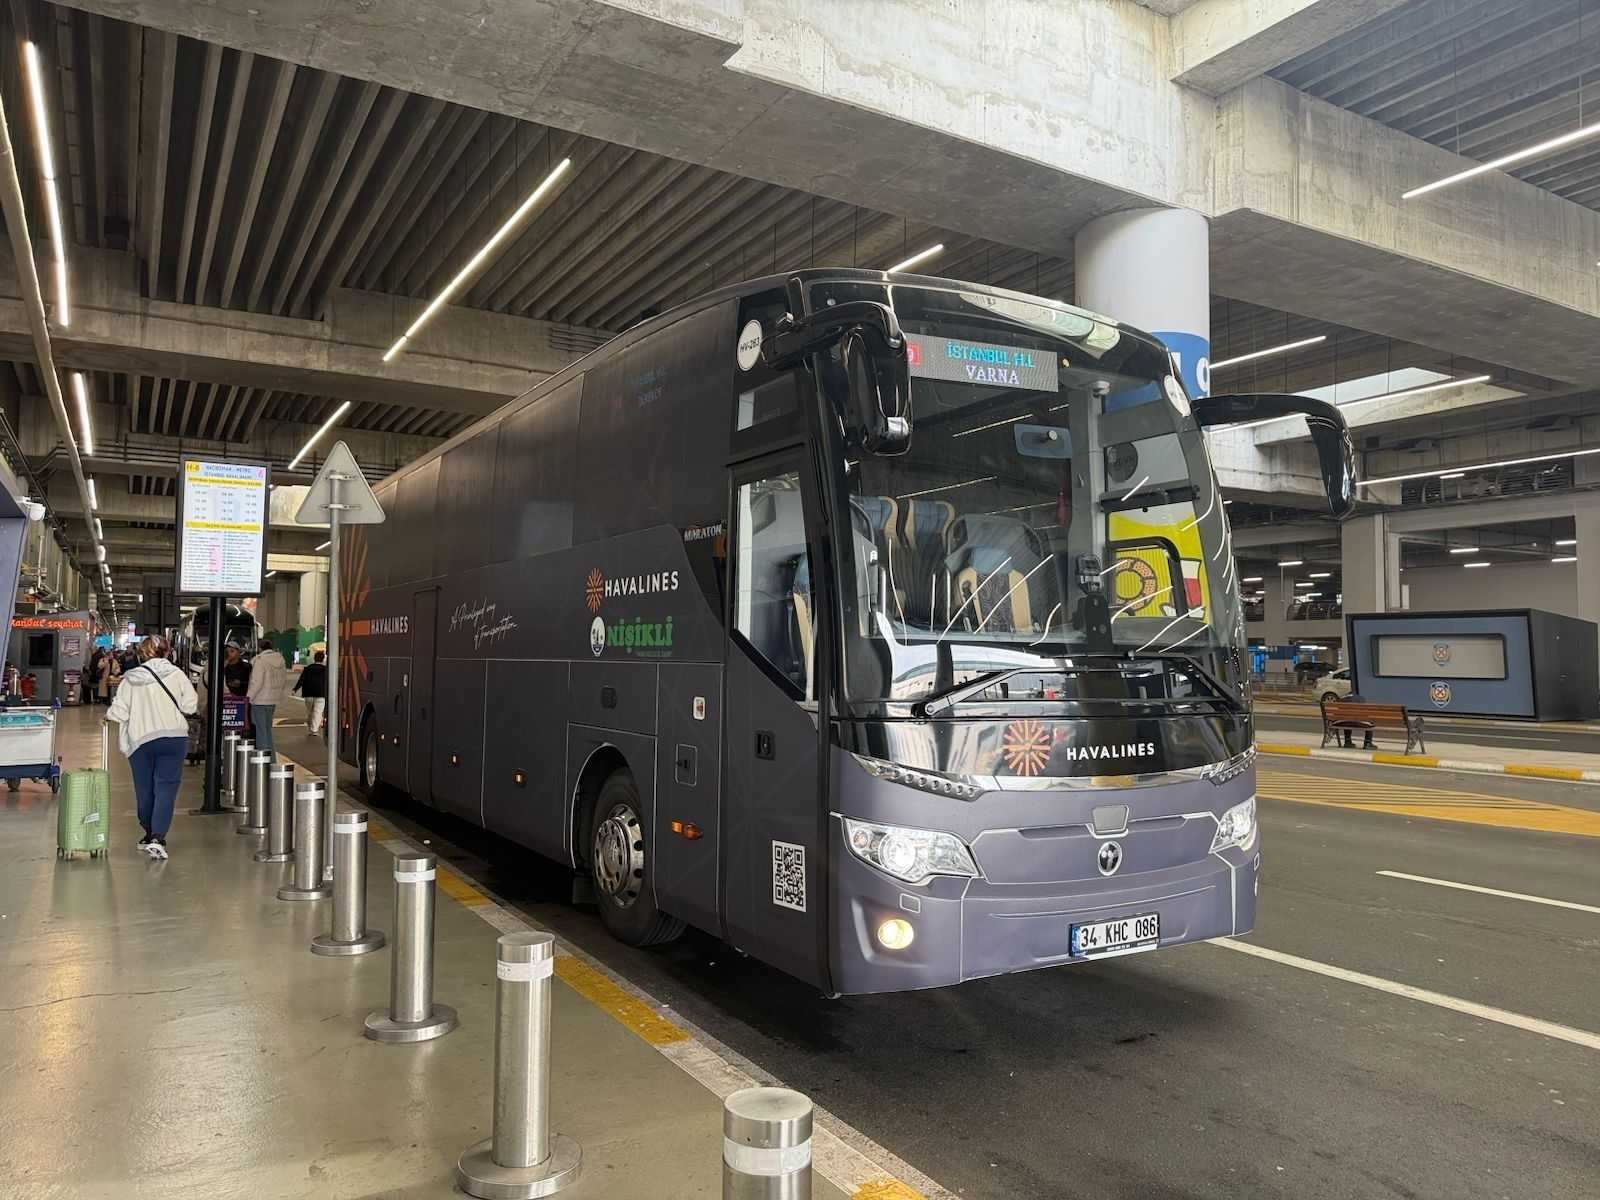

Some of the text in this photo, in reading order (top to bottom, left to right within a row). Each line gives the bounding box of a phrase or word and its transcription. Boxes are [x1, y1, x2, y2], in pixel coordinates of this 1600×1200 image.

[965, 364, 1020, 385] VARNA
[604, 570, 679, 598] HAVALINES
[370, 615, 409, 635] HAVALINES
[606, 615, 673, 654] NİŞİKLİ
[1066, 742, 1156, 761] HAVALINES
[1080, 926, 1098, 948] 34
[1105, 921, 1129, 944] KHC
[1135, 916, 1157, 938] 086
